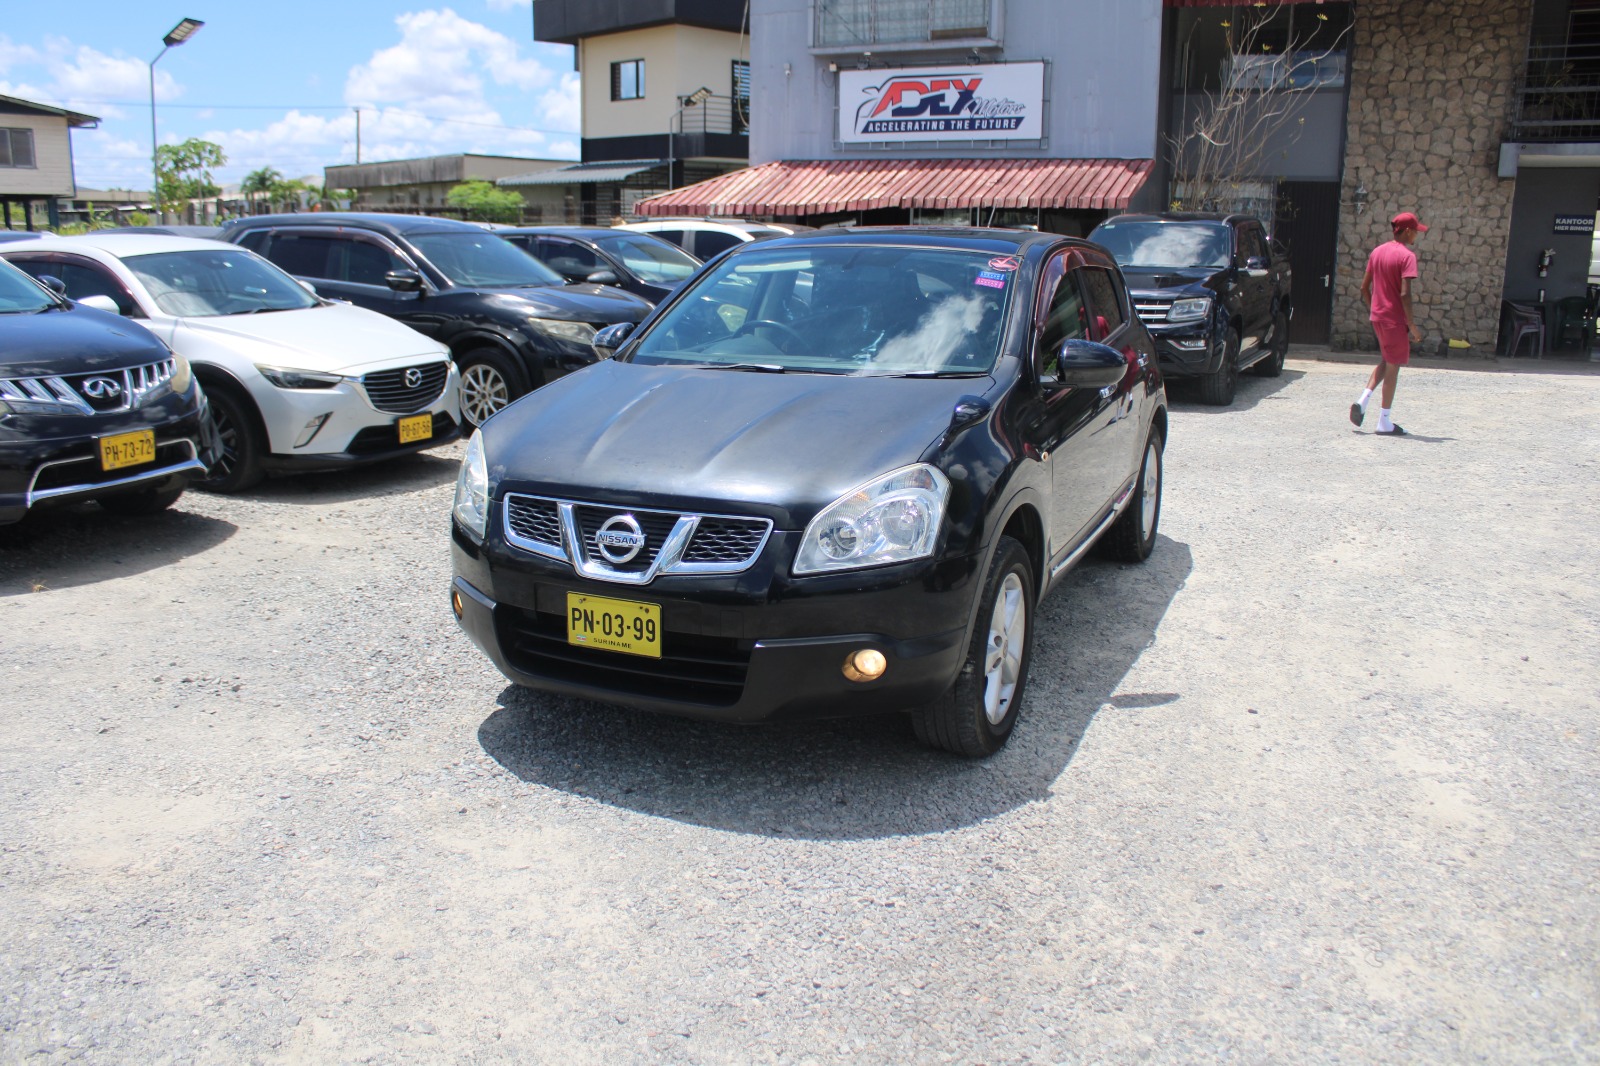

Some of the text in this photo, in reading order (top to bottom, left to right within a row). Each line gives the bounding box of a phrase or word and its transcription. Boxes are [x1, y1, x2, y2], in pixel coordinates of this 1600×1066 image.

[870, 78, 983, 118] ADEX
[964, 97, 1026, 118] Motors
[868, 118, 1017, 132] ACCELERATING THE FUTURE
[105, 438, 152, 463] PH-73-72
[598, 534, 638, 545] NISSAN
[571, 607, 656, 643] PN-03-99
[593, 637, 632, 649] SURINAME
